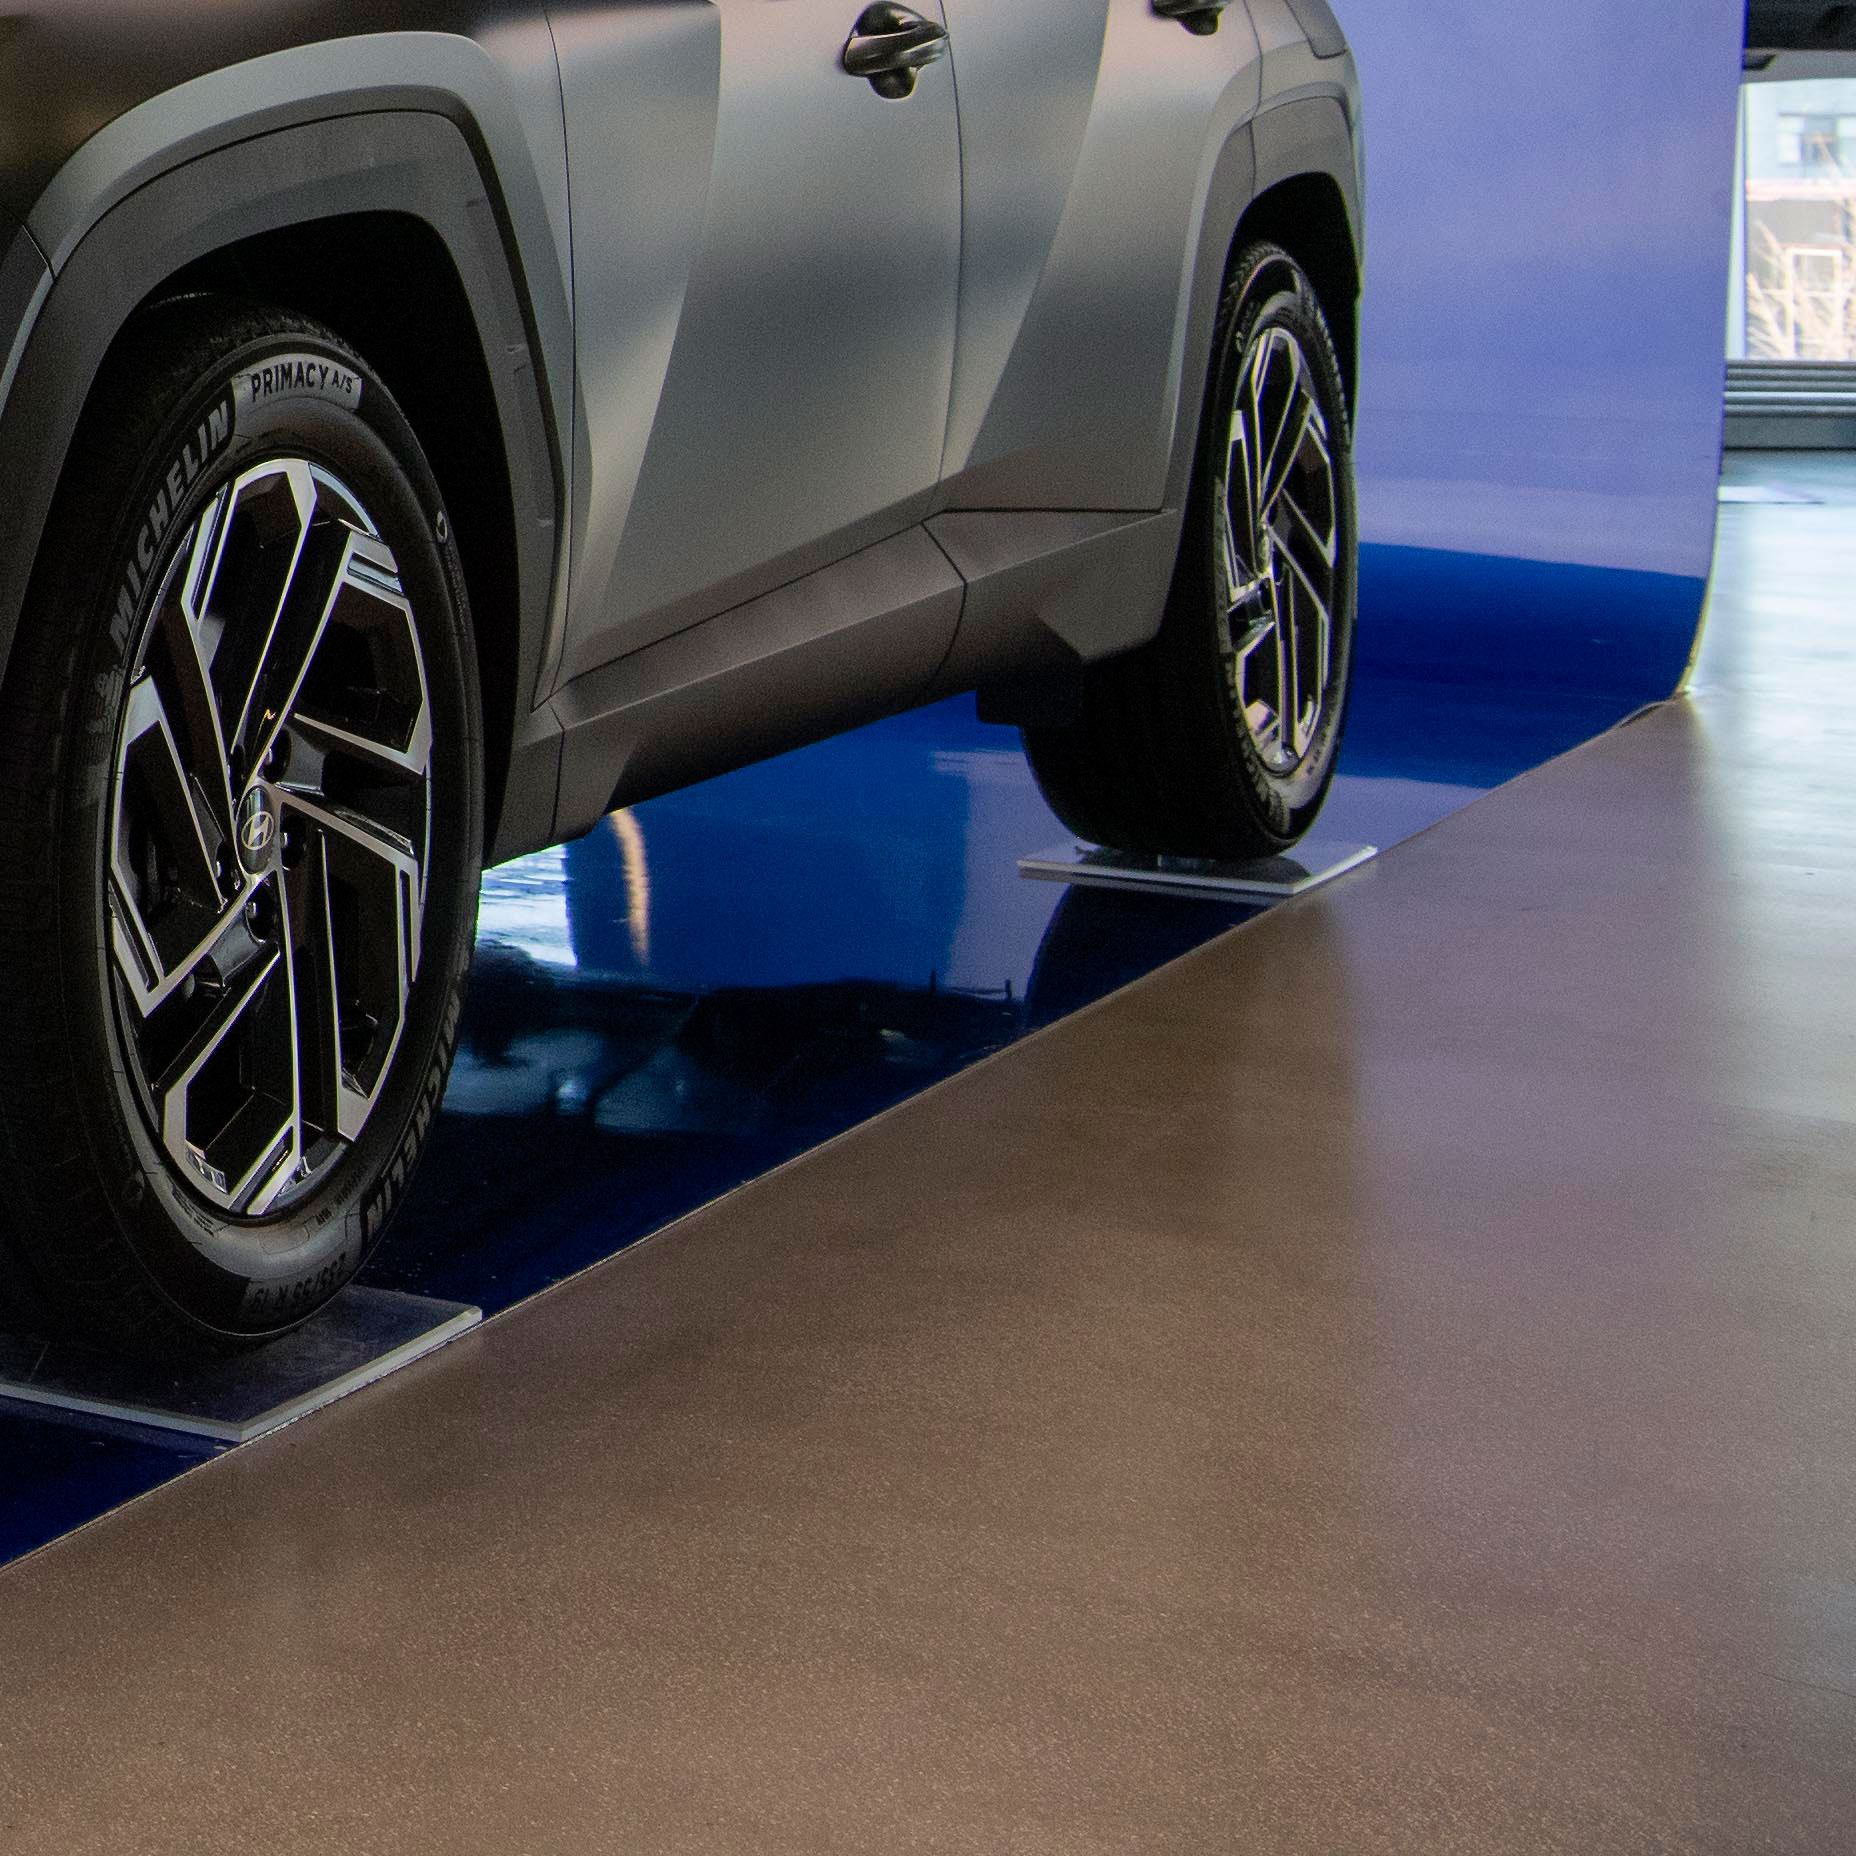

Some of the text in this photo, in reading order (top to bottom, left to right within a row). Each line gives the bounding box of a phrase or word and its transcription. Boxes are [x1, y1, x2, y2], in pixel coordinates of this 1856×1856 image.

[250, 361, 354, 403] PRIMACY A/S
[108, 399, 230, 659] MICHELIN
